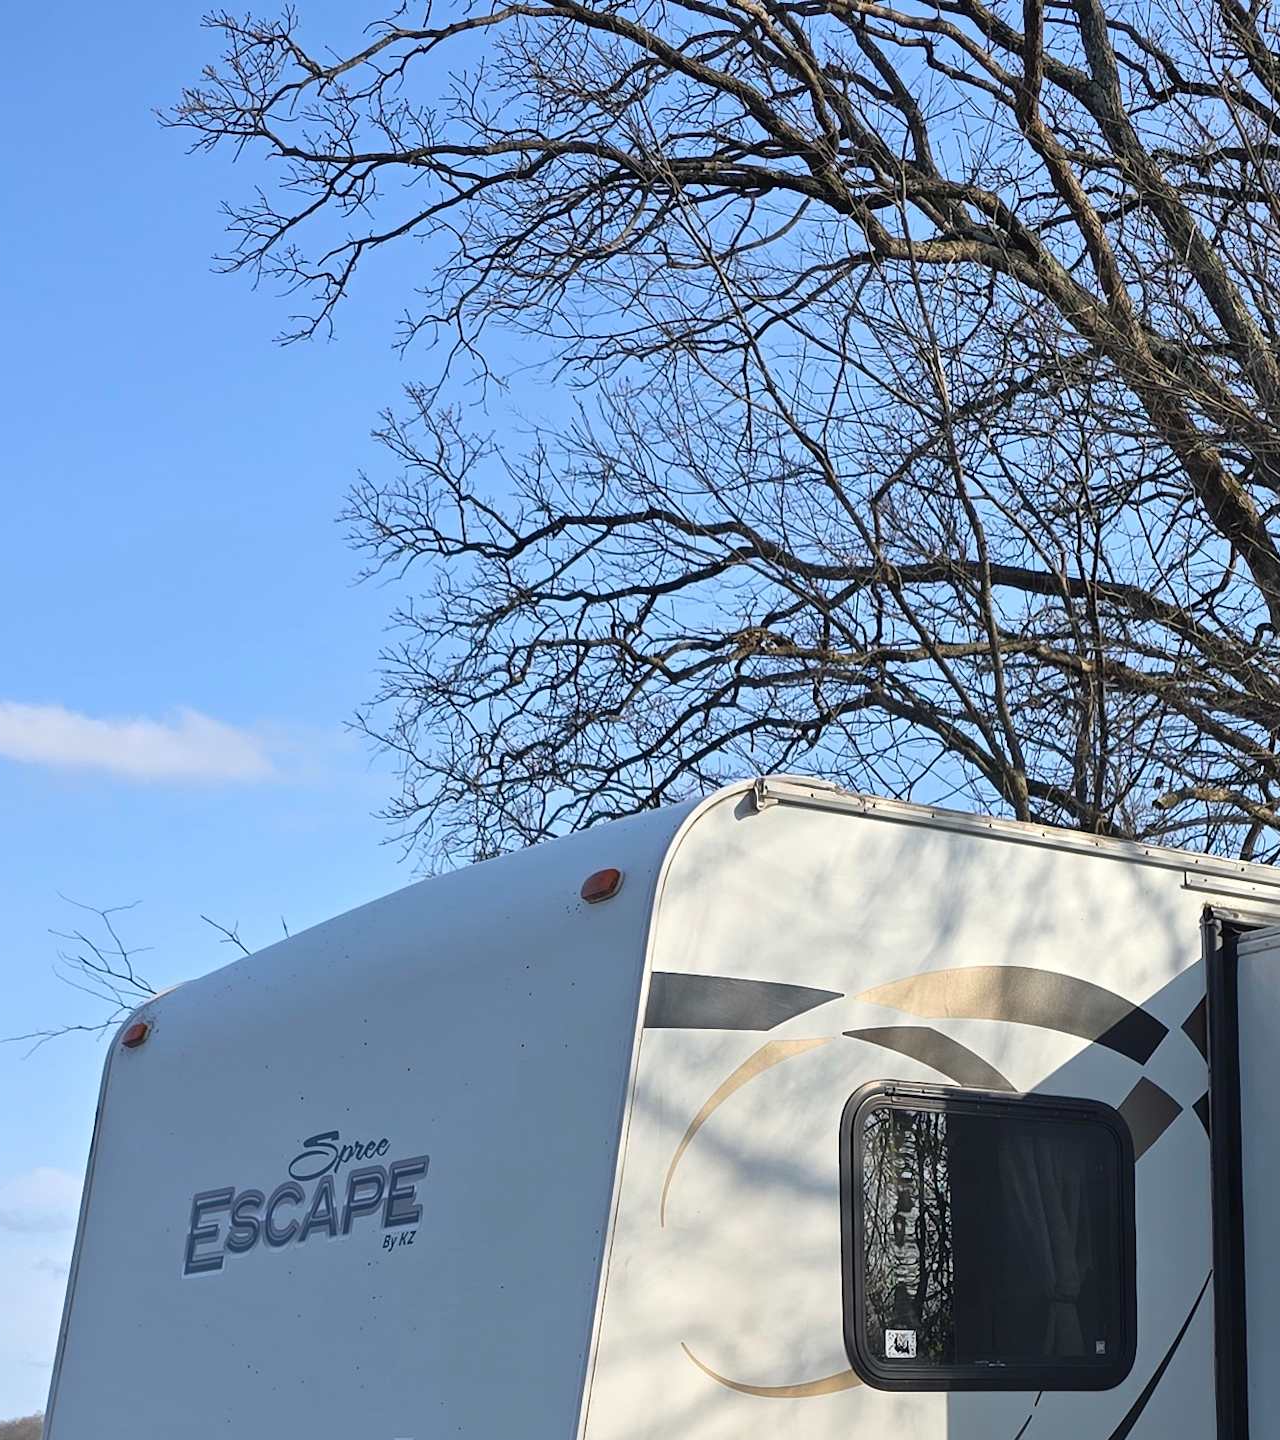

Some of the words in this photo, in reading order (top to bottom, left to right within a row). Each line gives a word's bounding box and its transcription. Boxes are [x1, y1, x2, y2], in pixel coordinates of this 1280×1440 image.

[288, 1130, 390, 1181] Spree
[184, 1155, 430, 1275] ESCAPE
[382, 1234, 398, 1252] By
[398, 1230, 417, 1246] KZ
